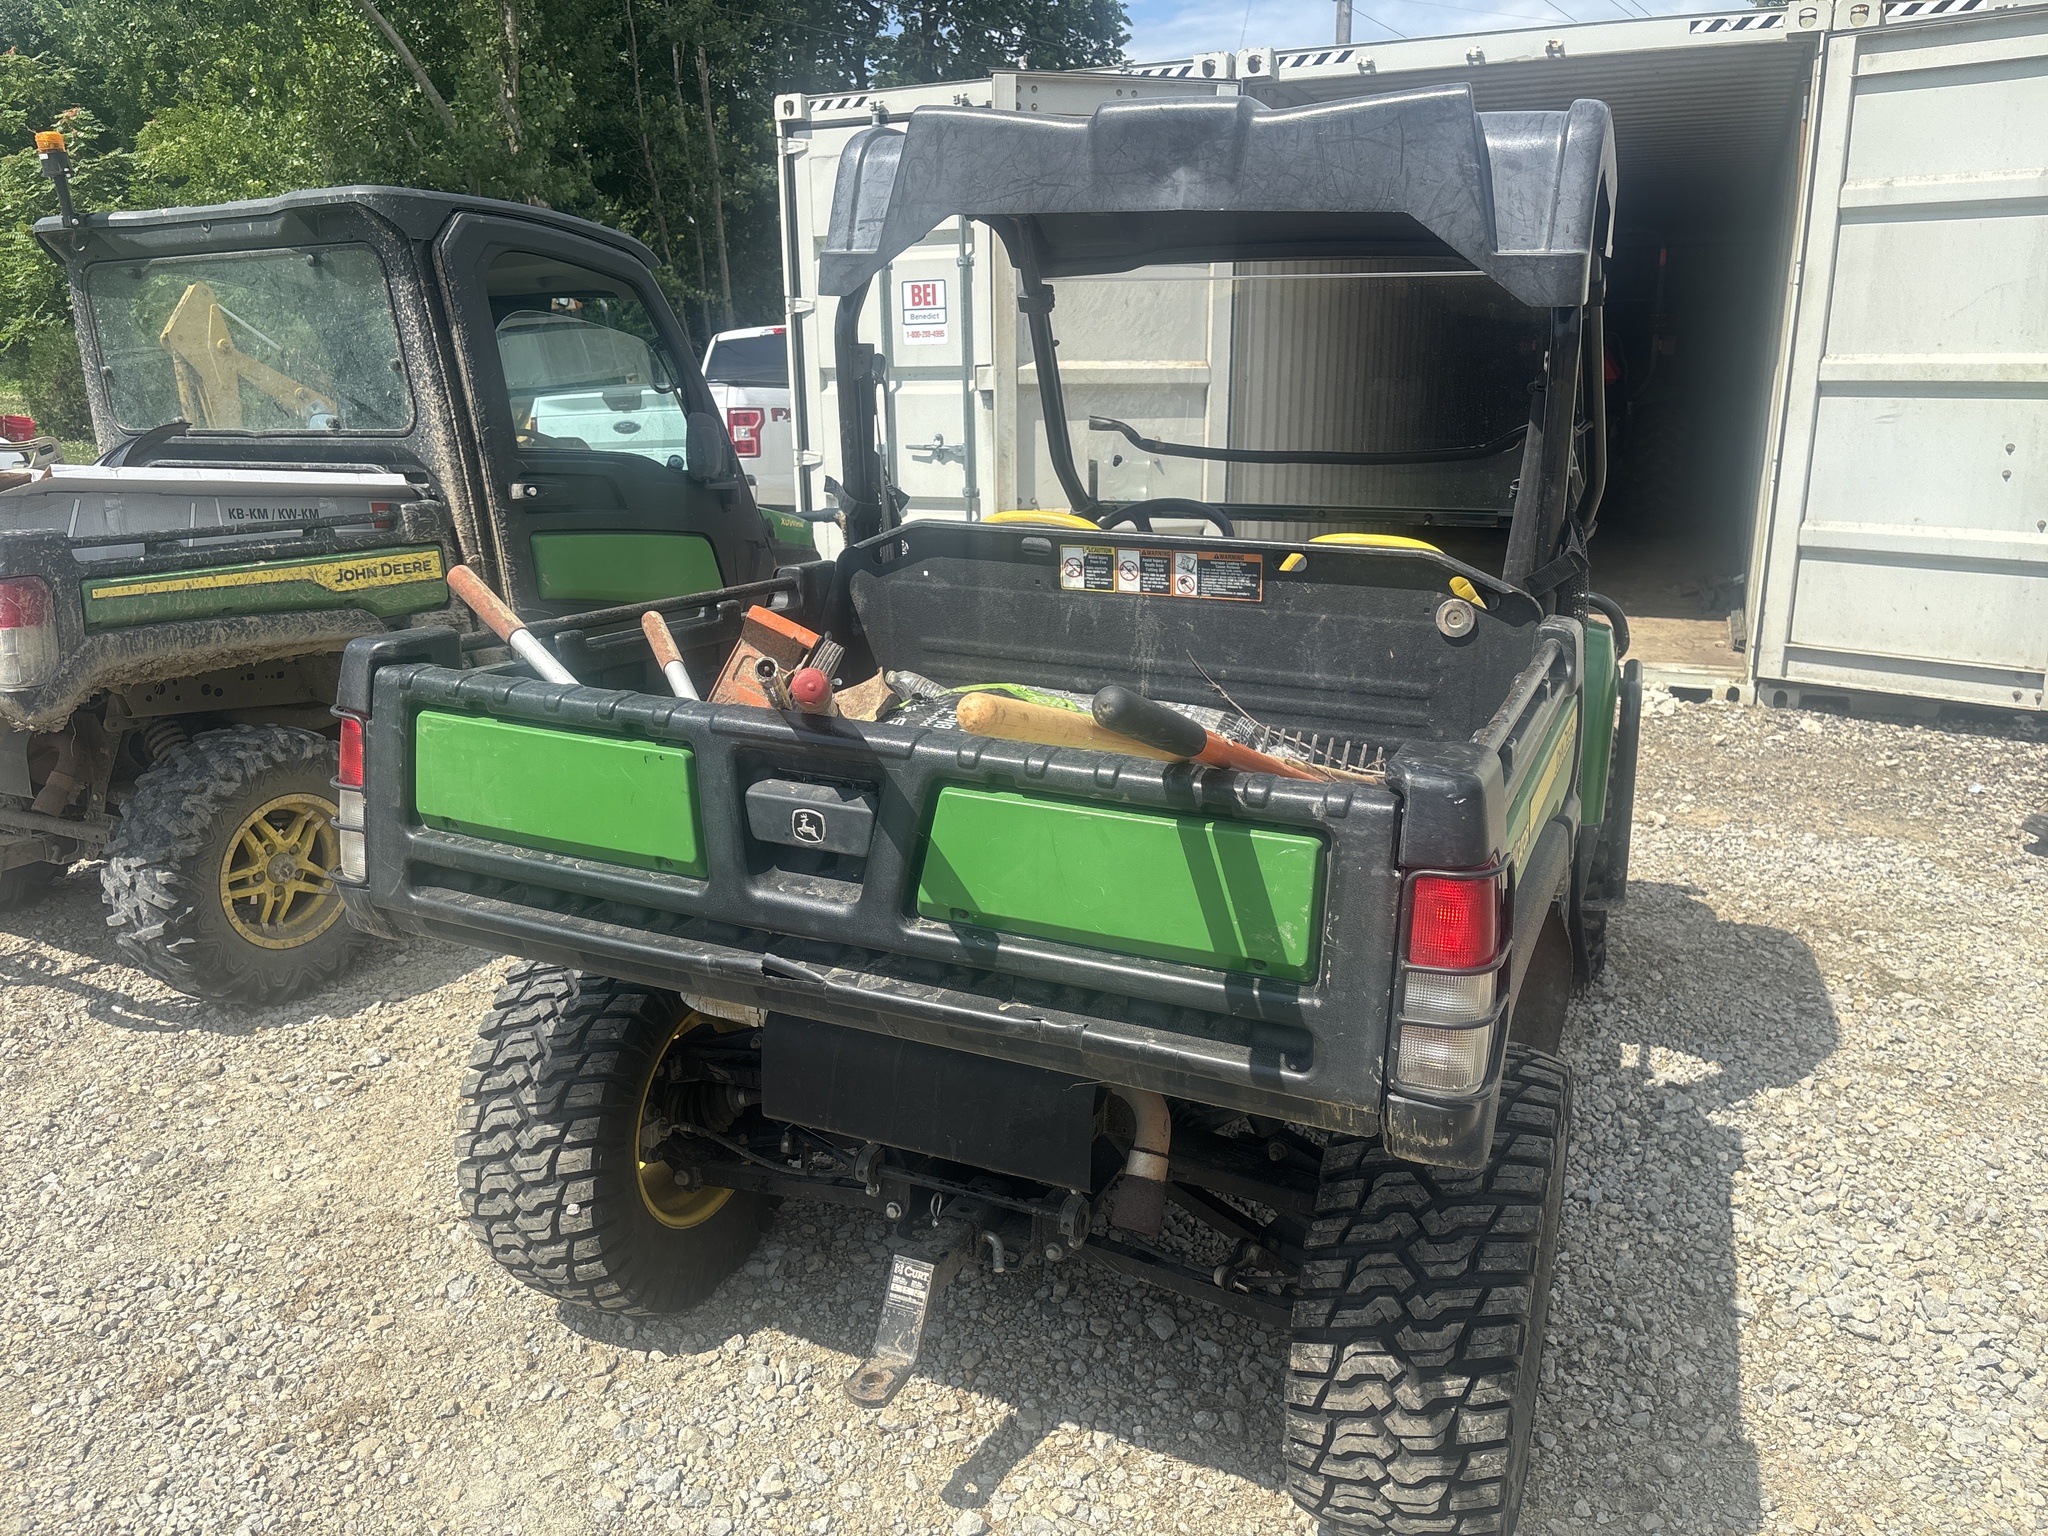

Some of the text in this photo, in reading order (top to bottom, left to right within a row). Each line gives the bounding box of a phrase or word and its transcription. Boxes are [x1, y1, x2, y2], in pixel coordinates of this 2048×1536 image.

[911, 284, 937, 306] BEI
[228, 507, 320, 521] KB-KM / KW-KM
[335, 559, 432, 583] JOHN DEERE
[904, 1266, 930, 1282] CURT
